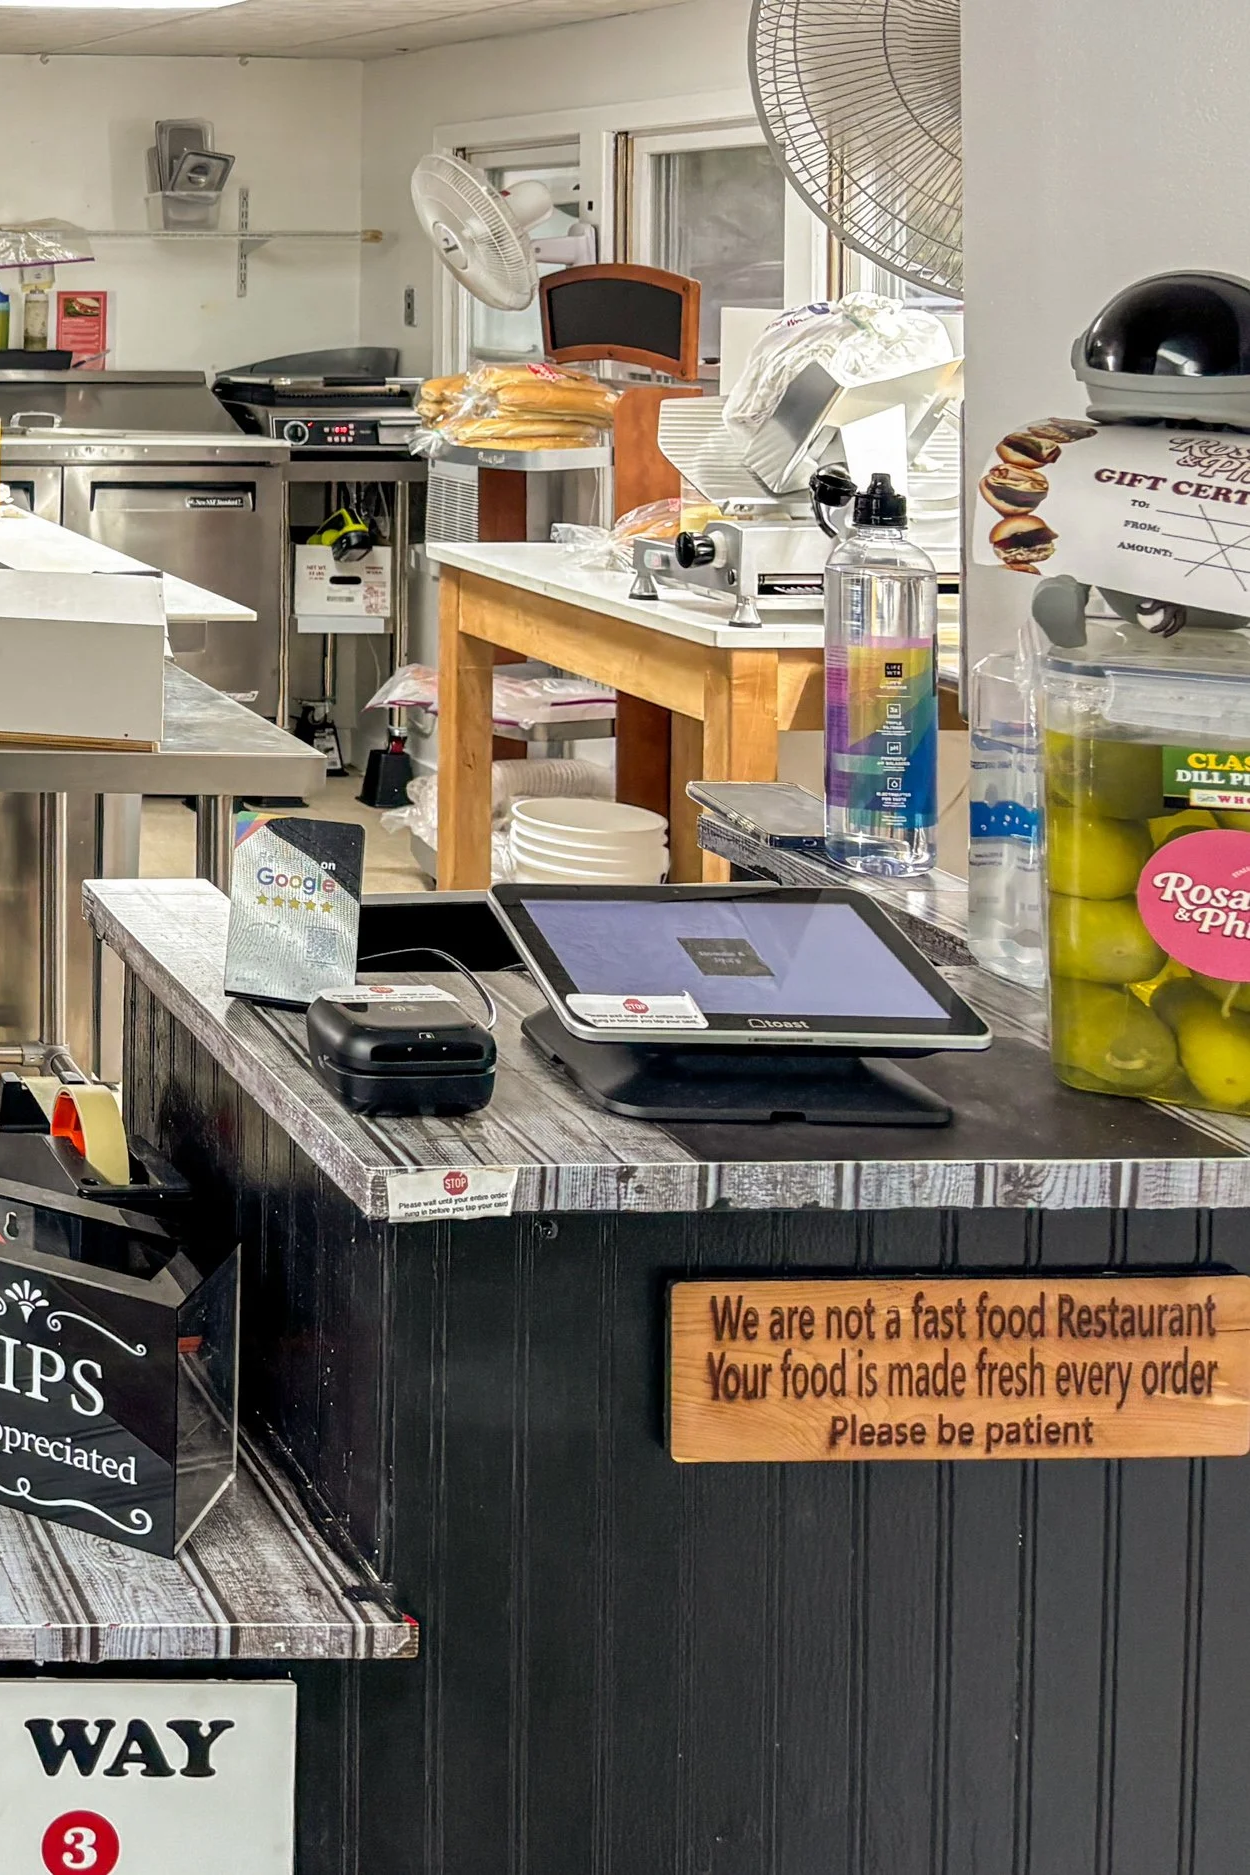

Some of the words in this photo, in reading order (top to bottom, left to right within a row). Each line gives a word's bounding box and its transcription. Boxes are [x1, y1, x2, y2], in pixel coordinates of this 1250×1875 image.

[1094, 468, 1167, 491] GIFT
[1172, 480, 1250, 505] CERT
[1130, 499, 1150, 509] TO:
[1123, 519, 1161, 533] FROM:
[1117, 541, 1173, 558] AMOUNT:
[1175, 769, 1226, 784] DILL
[320, 860, 336, 871] on
[257, 867, 335, 895] Google
[1152, 872, 1250, 911] Rosa
[1174, 907, 1191, 921] &
[766, 1019, 810, 1029] toast
[445, 1178, 467, 1190] STOP
[398, 1201, 422, 1210] Please
[454, 1196, 469, 1206] your
[470, 1193, 489, 1202] entire
[490, 1191, 508, 1200] order
[429, 1206, 450, 1215] before
[452, 1206, 464, 1214] you
[478, 1203, 493, 1211] your
[710, 1294, 759, 1341] We
[769, 1304, 815, 1341] are
[826, 1299, 876, 1340] not
[885, 1304, 902, 1340] a
[912, 1292, 966, 1340] fast
[976, 1291, 1046, 1339] food
[1057, 1293, 1217, 1338] Restaurant
[707, 1351, 772, 1400] Your
[781, 1349, 846, 1399] food
[857, 1349, 878, 1397] is
[888, 1348, 966, 1397] made
[976, 1346, 1046, 1397] fresh
[1055, 1358, 1133, 1409] every
[1141, 1347, 1218, 1395] order
[829, 1415, 926, 1449] Please
[937, 1414, 974, 1446] be
[986, 1414, 1094, 1452] patient
[24, 1718, 236, 1778] WAY
[62, 1826, 98, 1870] 3
